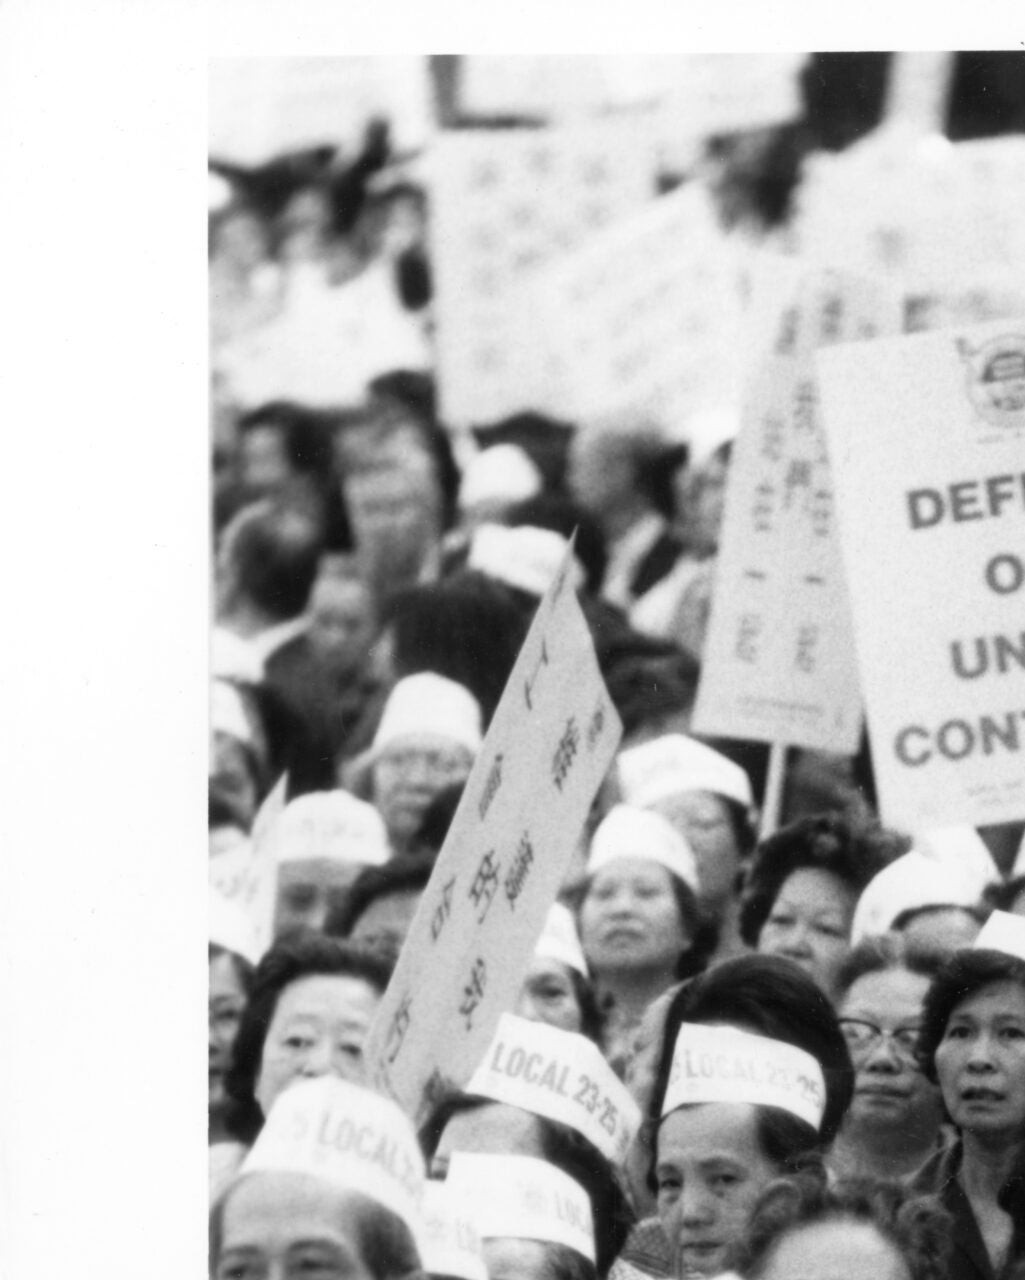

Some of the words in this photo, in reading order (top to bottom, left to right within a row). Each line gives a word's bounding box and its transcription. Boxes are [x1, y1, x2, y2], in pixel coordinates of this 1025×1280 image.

[489, 1043, 571, 1097] LOCAL
[572, 1073, 620, 1137] 23-25
[684, 1049, 763, 1085] LOCAL
[317, 1109, 399, 1179] LOCAL
